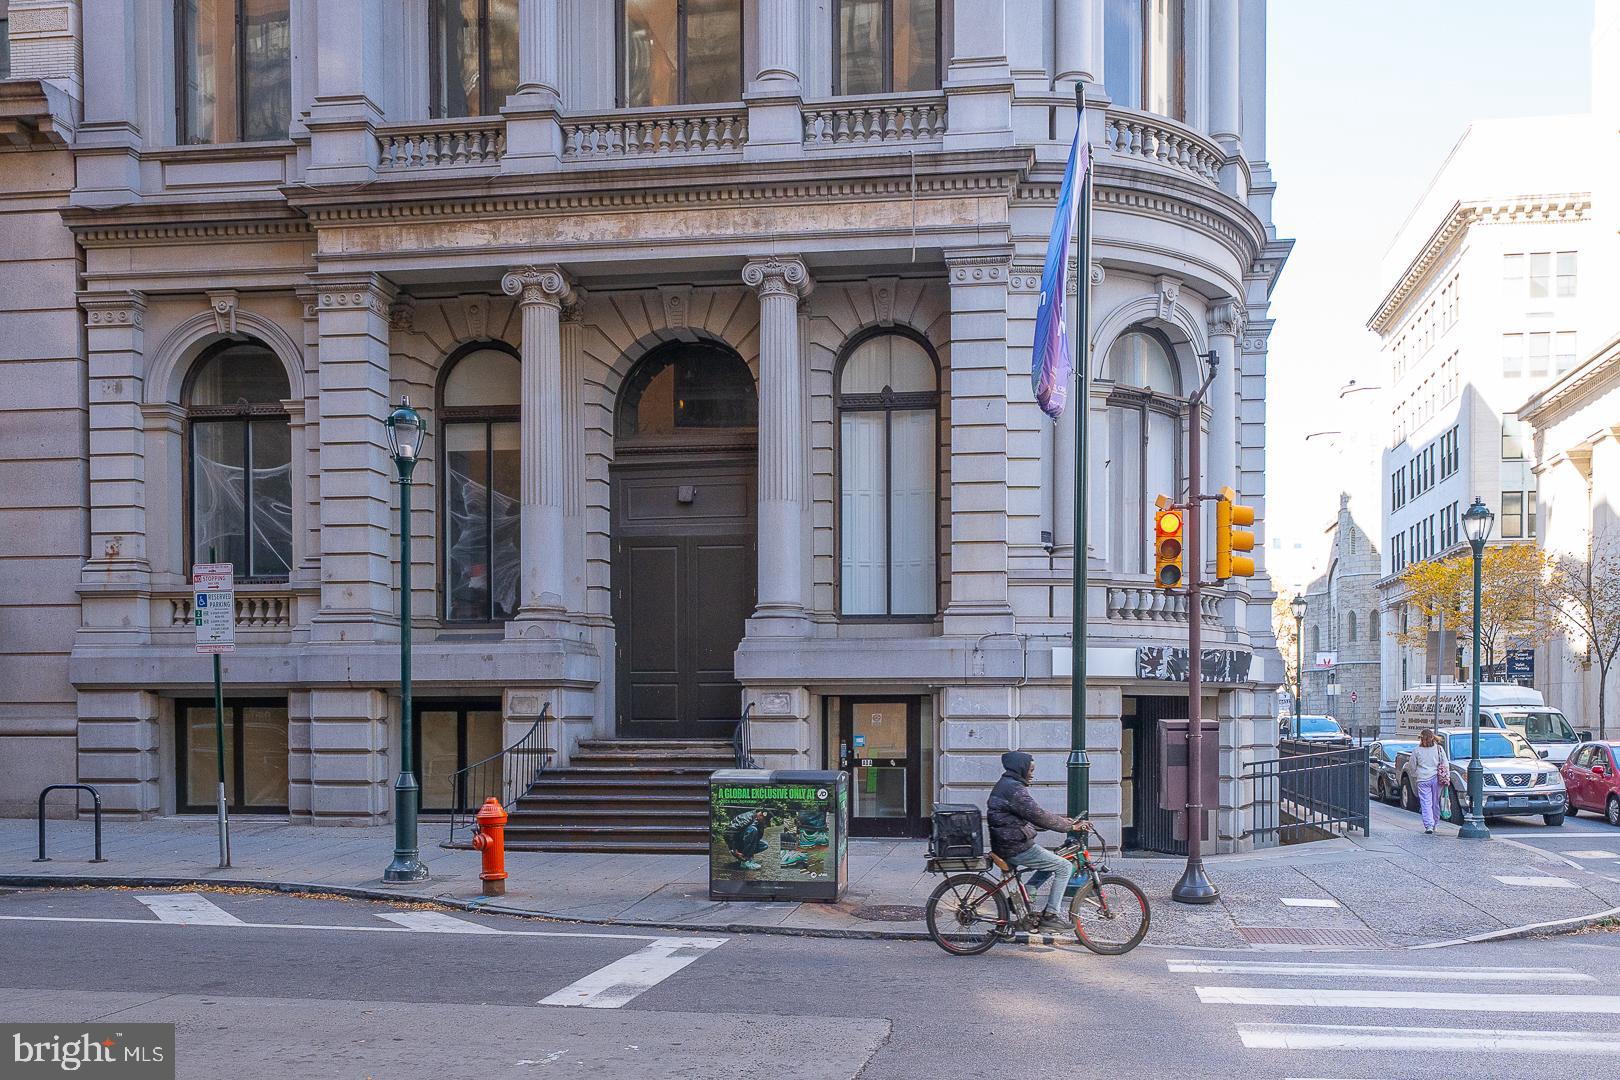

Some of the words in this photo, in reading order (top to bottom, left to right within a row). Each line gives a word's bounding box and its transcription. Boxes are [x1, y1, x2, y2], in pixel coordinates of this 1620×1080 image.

[208, 593, 231, 601] RESERVED
[1429, 694, 1453, 704] Coice
[718, 788, 724, 799] A
[724, 788, 751, 799] GLOBAL
[751, 788, 788, 799] EXCLUSIVE
[789, 788, 806, 799] ONLY
[806, 788, 816, 800] AT
